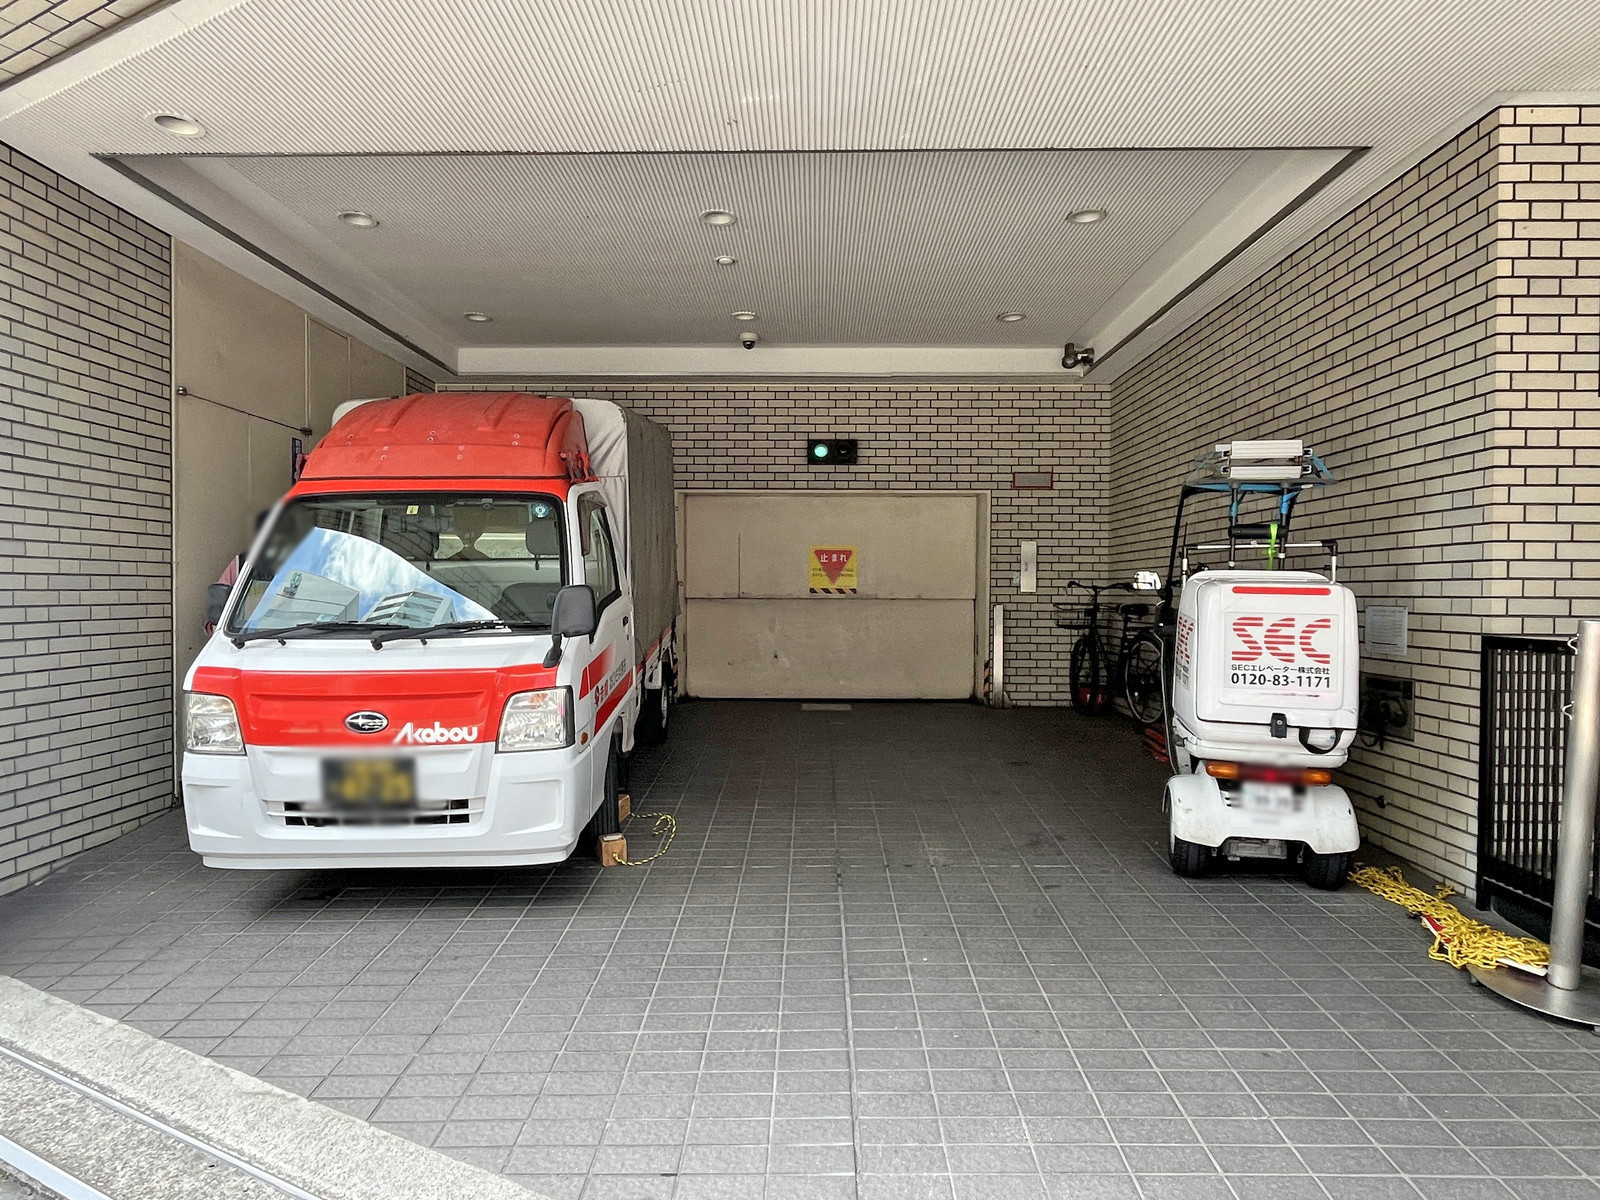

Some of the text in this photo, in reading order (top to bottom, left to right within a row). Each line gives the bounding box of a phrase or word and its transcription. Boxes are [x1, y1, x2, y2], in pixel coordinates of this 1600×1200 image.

[820, 552, 847, 563] 止まれ
[1232, 617, 1331, 664] SEC
[1231, 664, 1330, 675] SECエレベーター株式会社
[1231, 673, 1330, 688] 0120-83-1171
[393, 721, 478, 744] Akabou
